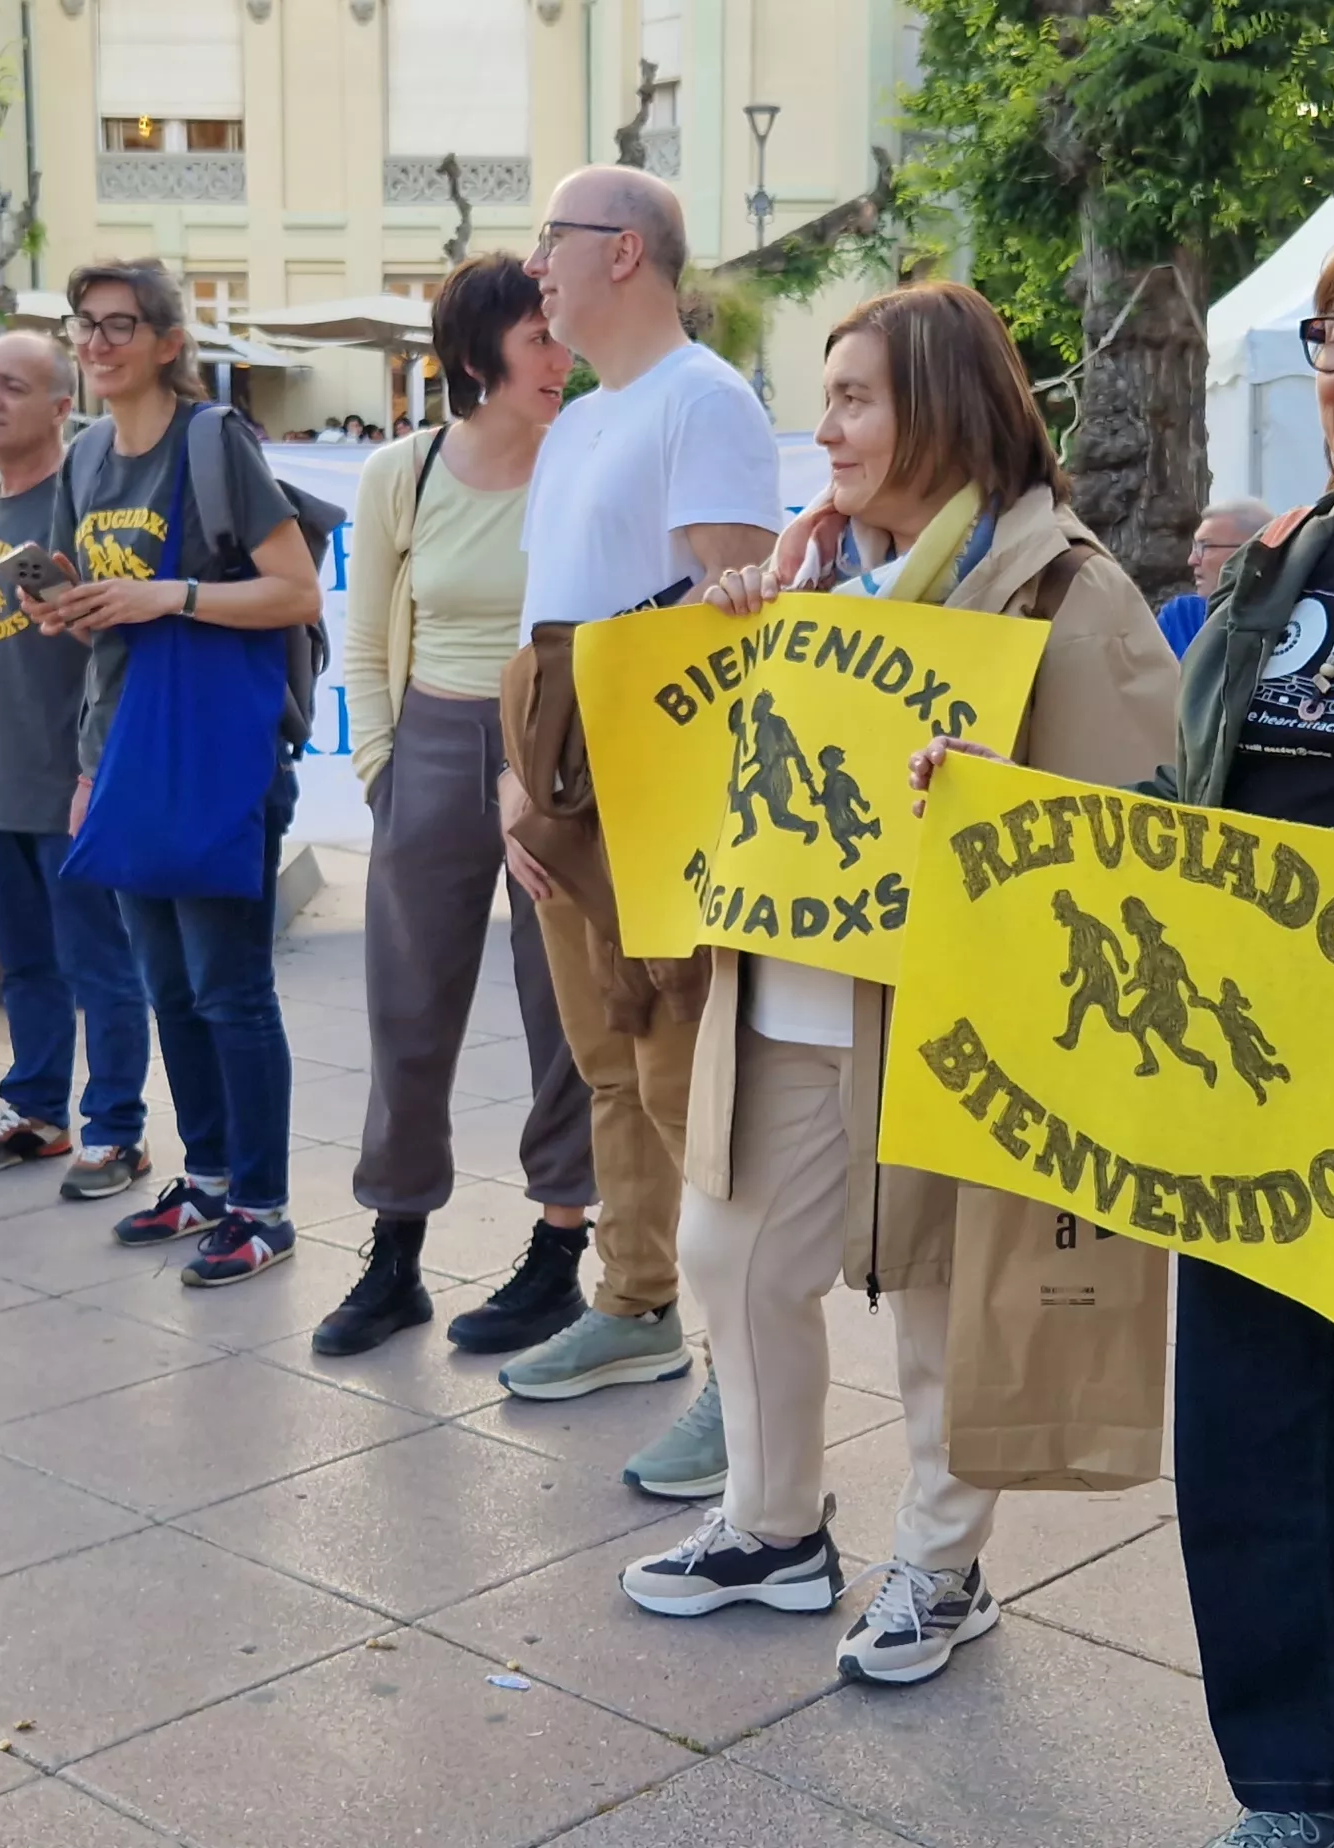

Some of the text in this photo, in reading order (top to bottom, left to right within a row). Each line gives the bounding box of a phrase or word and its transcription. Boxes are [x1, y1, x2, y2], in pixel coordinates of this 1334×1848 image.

[654, 619, 978, 738] BIENVENIDXS
[1257, 710, 1298, 728] heart
[683, 848, 910, 942] RGIADXS
